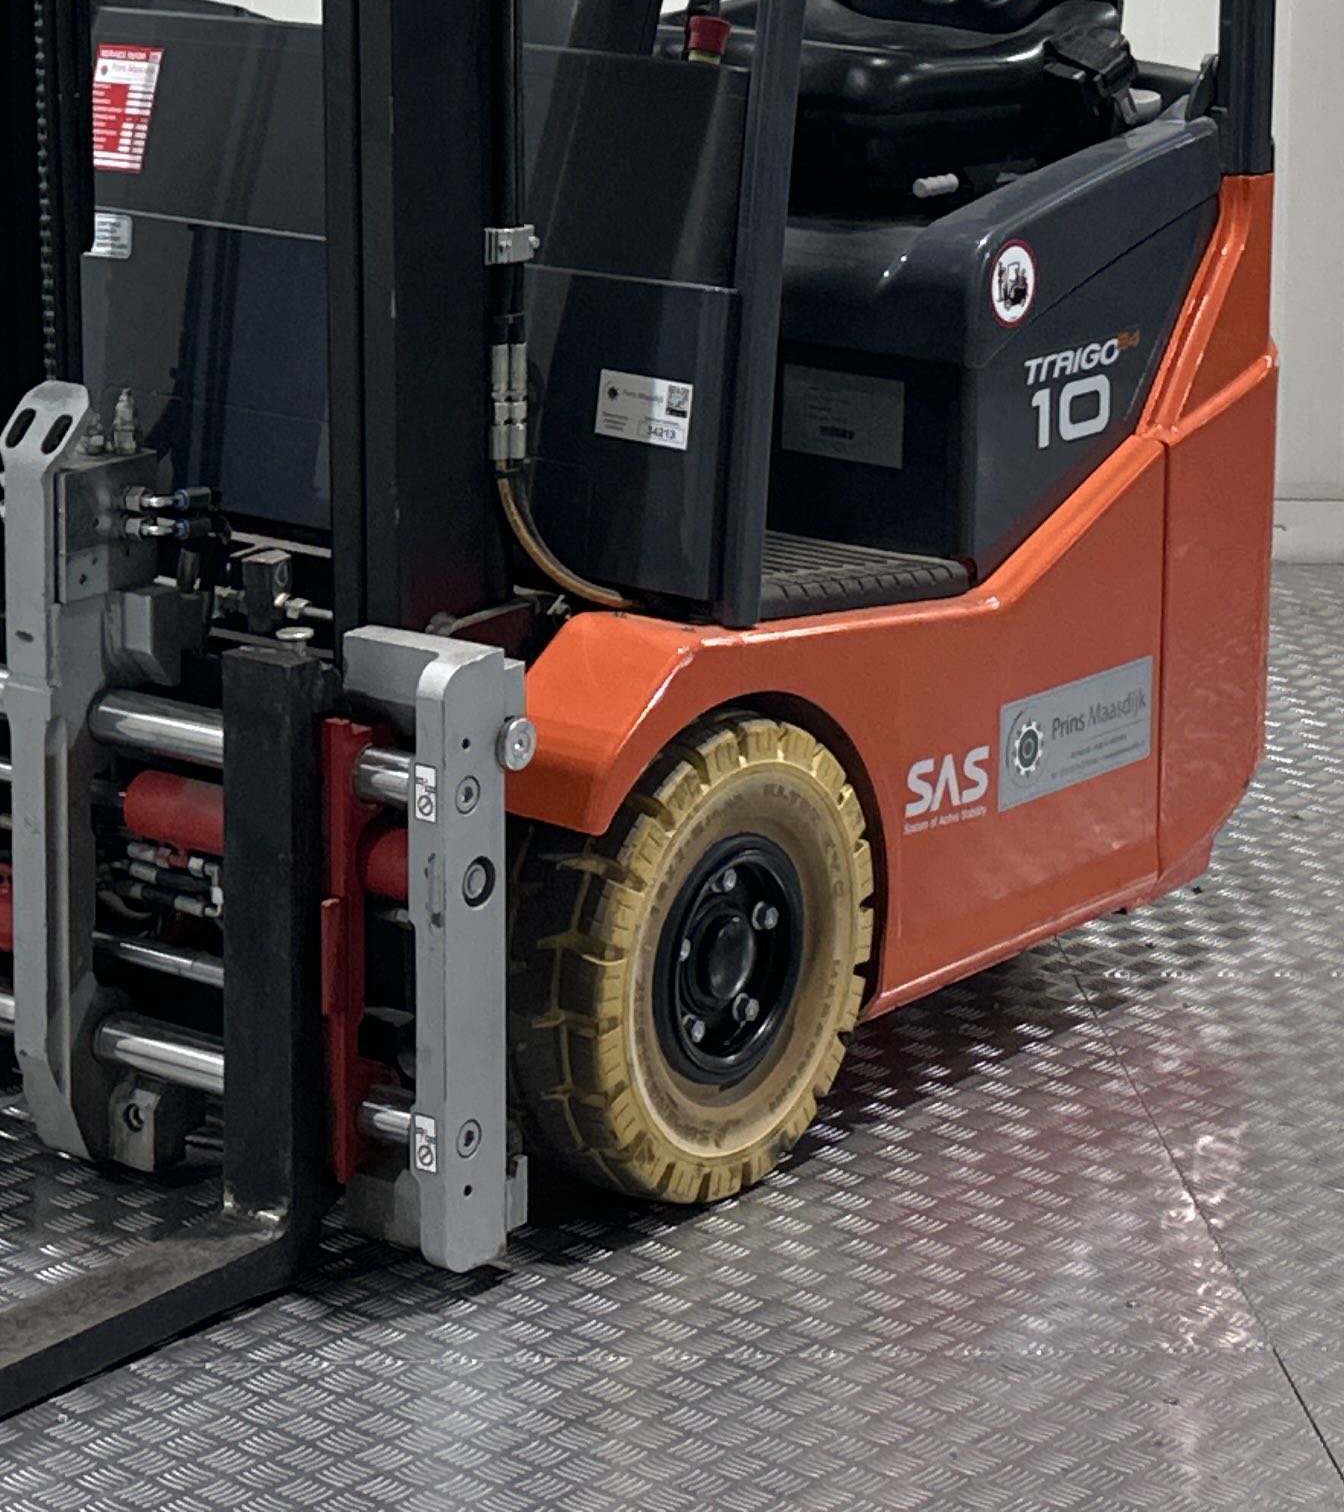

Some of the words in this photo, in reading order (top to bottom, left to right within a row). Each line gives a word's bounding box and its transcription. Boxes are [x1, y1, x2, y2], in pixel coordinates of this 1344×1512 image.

[1031, 374, 1111, 449] 10
[1051, 714, 1086, 741] Prins
[905, 745, 990, 818] SAS
